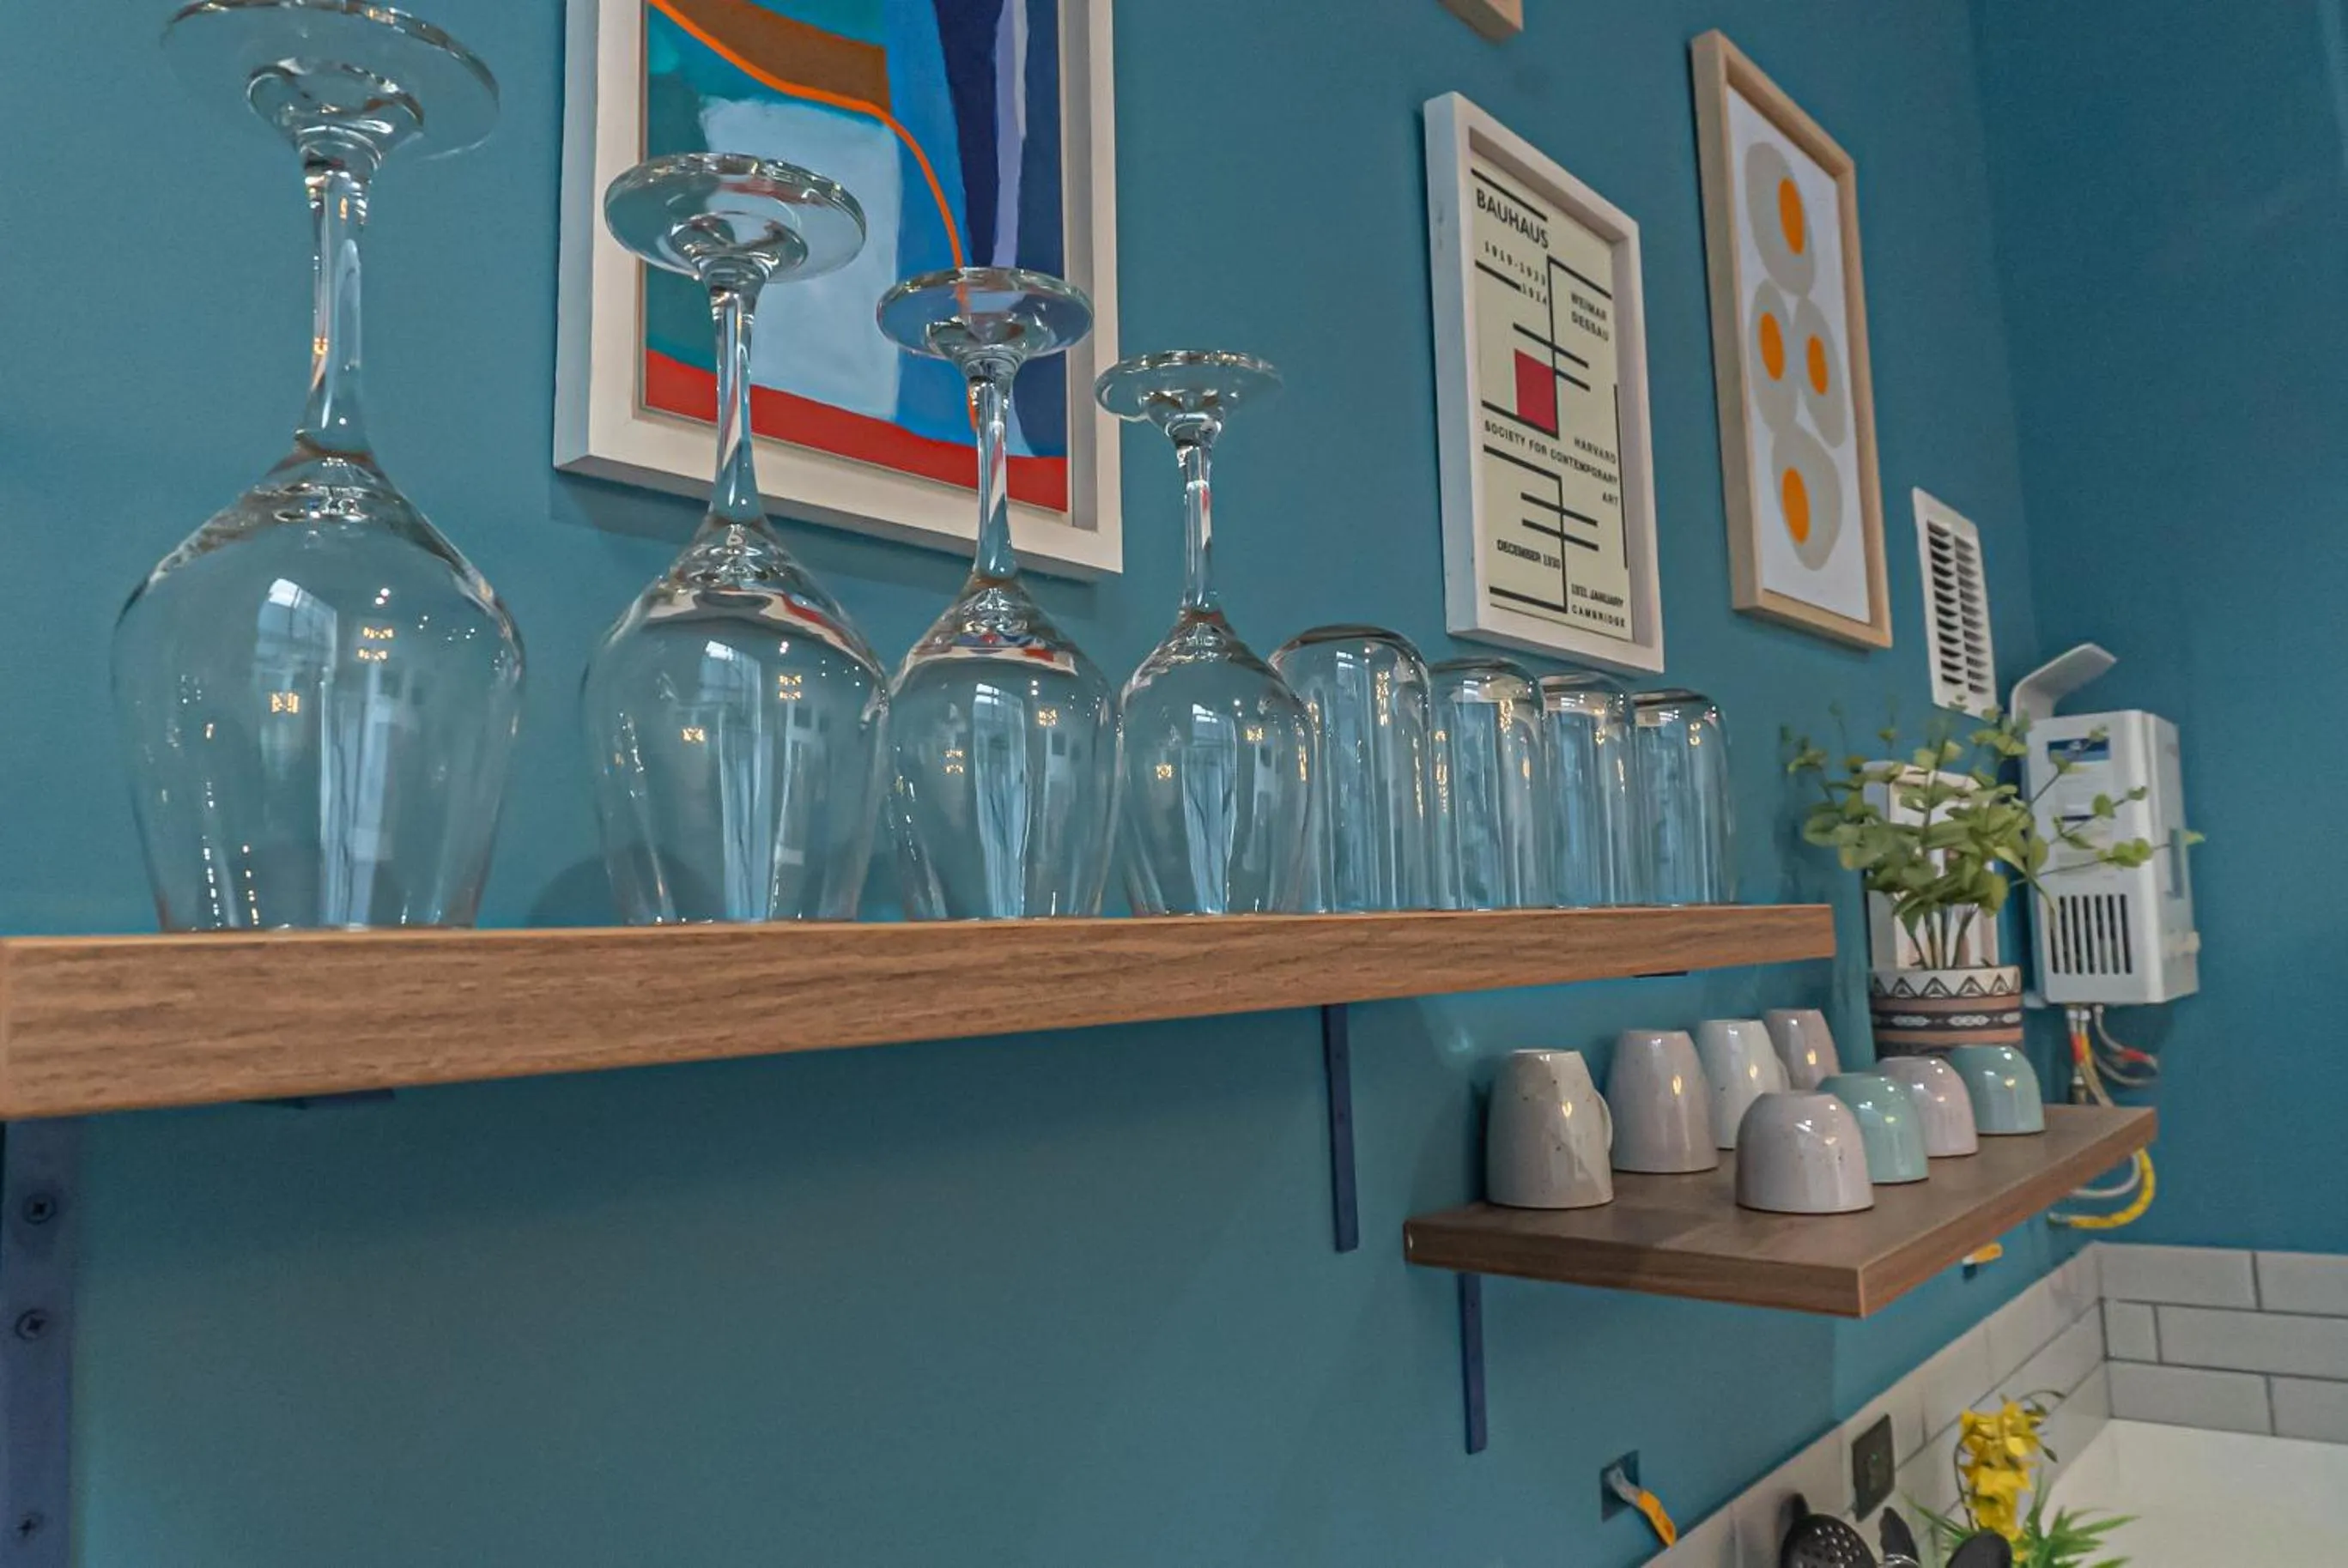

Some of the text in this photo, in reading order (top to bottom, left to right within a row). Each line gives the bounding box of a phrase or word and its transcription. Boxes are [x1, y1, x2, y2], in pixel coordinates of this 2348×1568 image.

[1477, 188, 1549, 249] BAUHAUS
[1570, 292, 1607, 321] WEIMAR
[1571, 311, 1610, 342] DESSAU
[1484, 420, 1617, 485] SOCIETY FOR CONTEMPORARY
[1574, 437, 1617, 464] HARVARD
[1602, 492, 1618, 506] ART
[1496, 539, 1541, 563] DECEMBER
[1571, 603, 1625, 628] CAMBRIDGE
